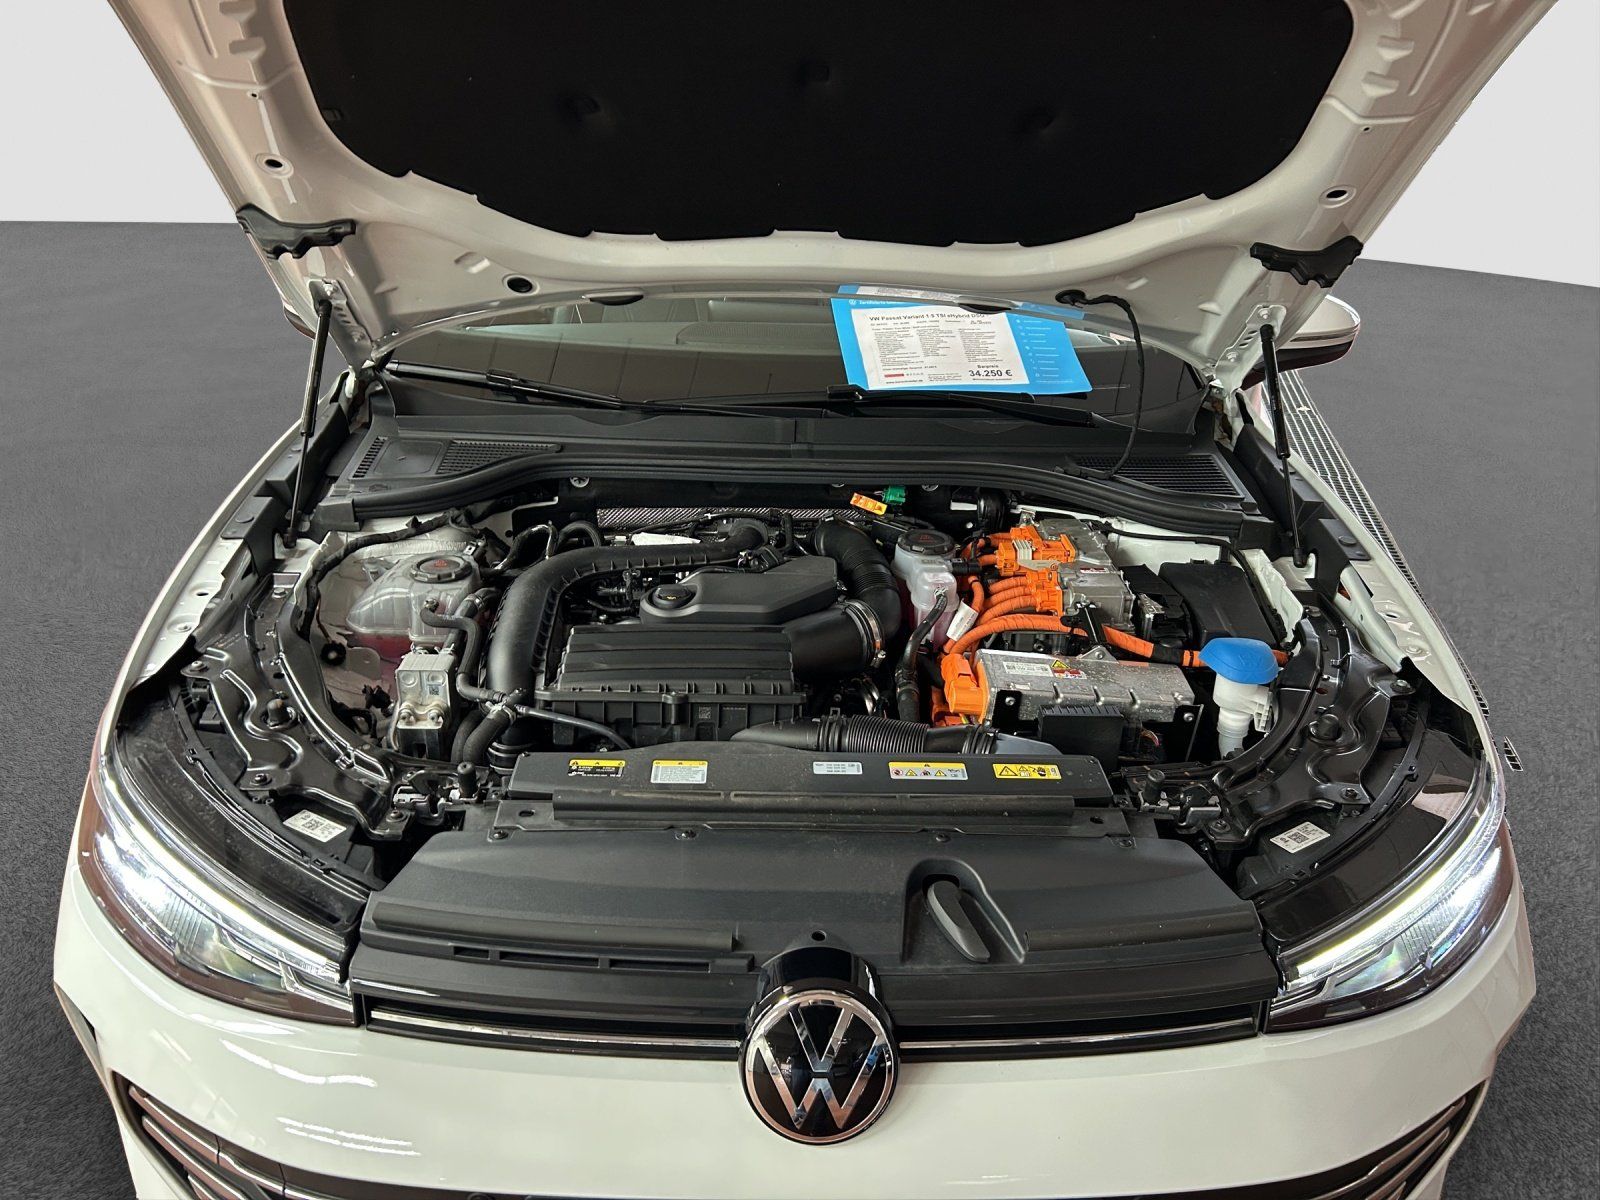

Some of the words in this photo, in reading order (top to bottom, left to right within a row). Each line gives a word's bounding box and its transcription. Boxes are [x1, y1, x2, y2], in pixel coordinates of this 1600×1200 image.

[968, 369, 1003, 377] 34.250
[1005, 369, 1013, 377] €
[749, 996, 890, 1136] VW
